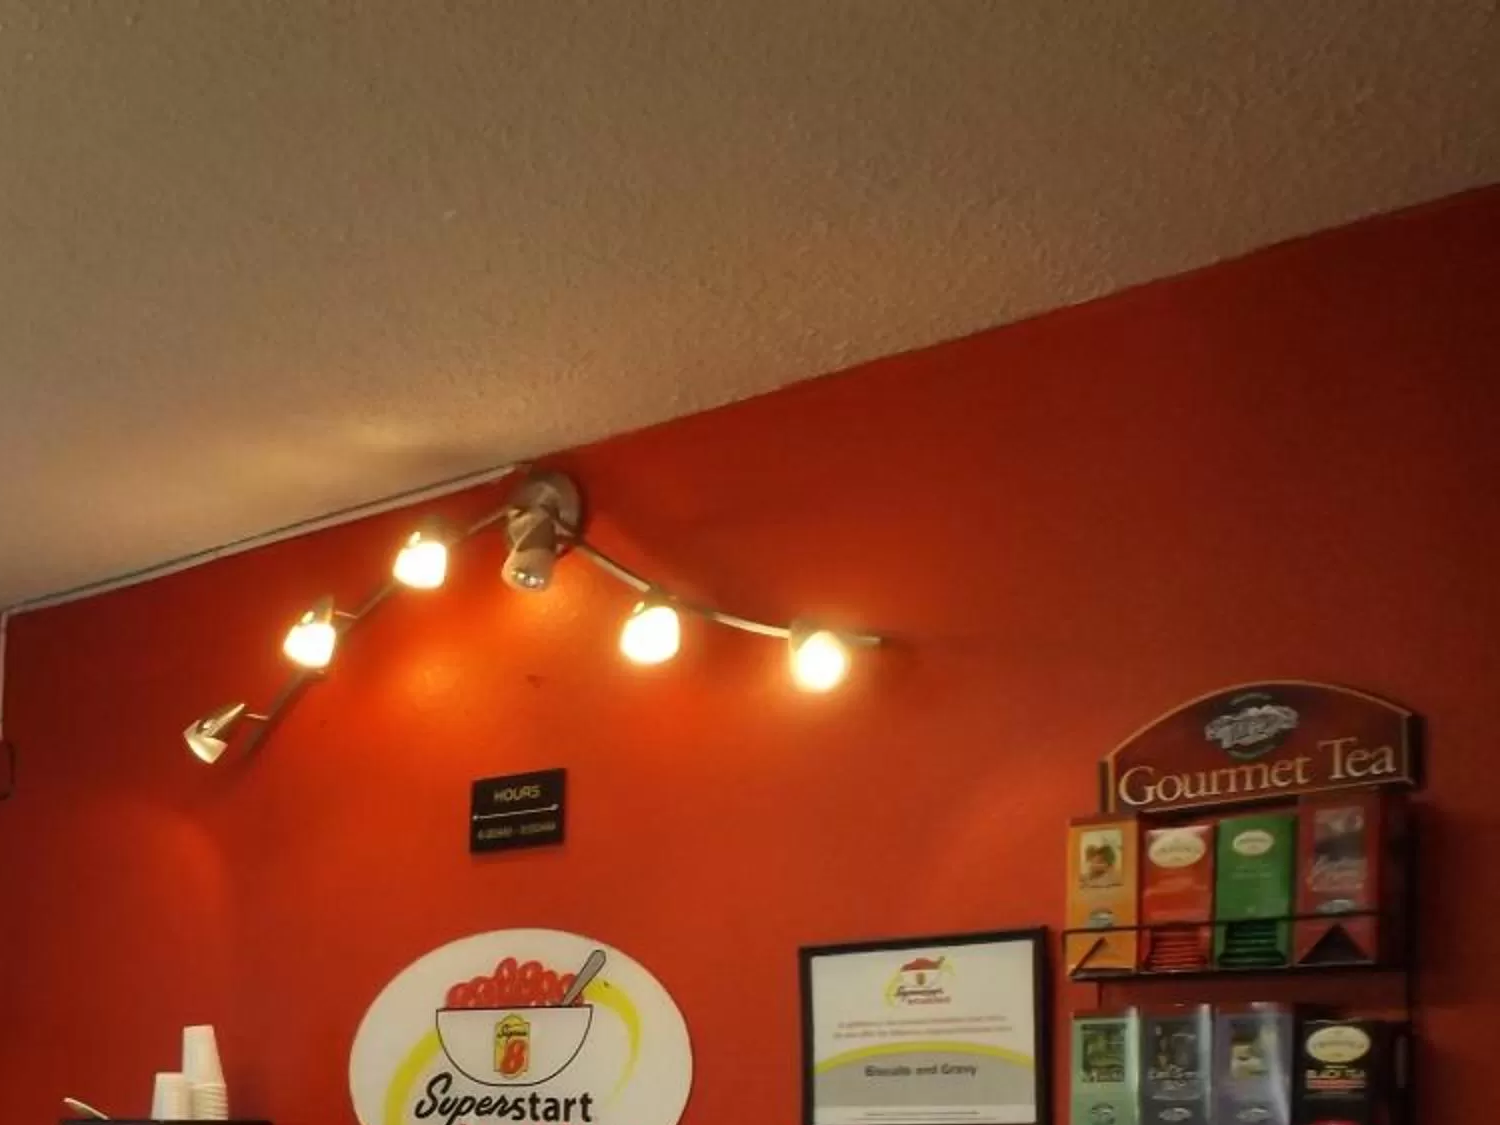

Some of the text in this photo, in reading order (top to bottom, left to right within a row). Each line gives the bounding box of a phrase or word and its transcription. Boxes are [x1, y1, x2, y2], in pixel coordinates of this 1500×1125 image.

[1118, 736, 1397, 806] Gourmet Tea
[494, 785, 541, 801] HOURS
